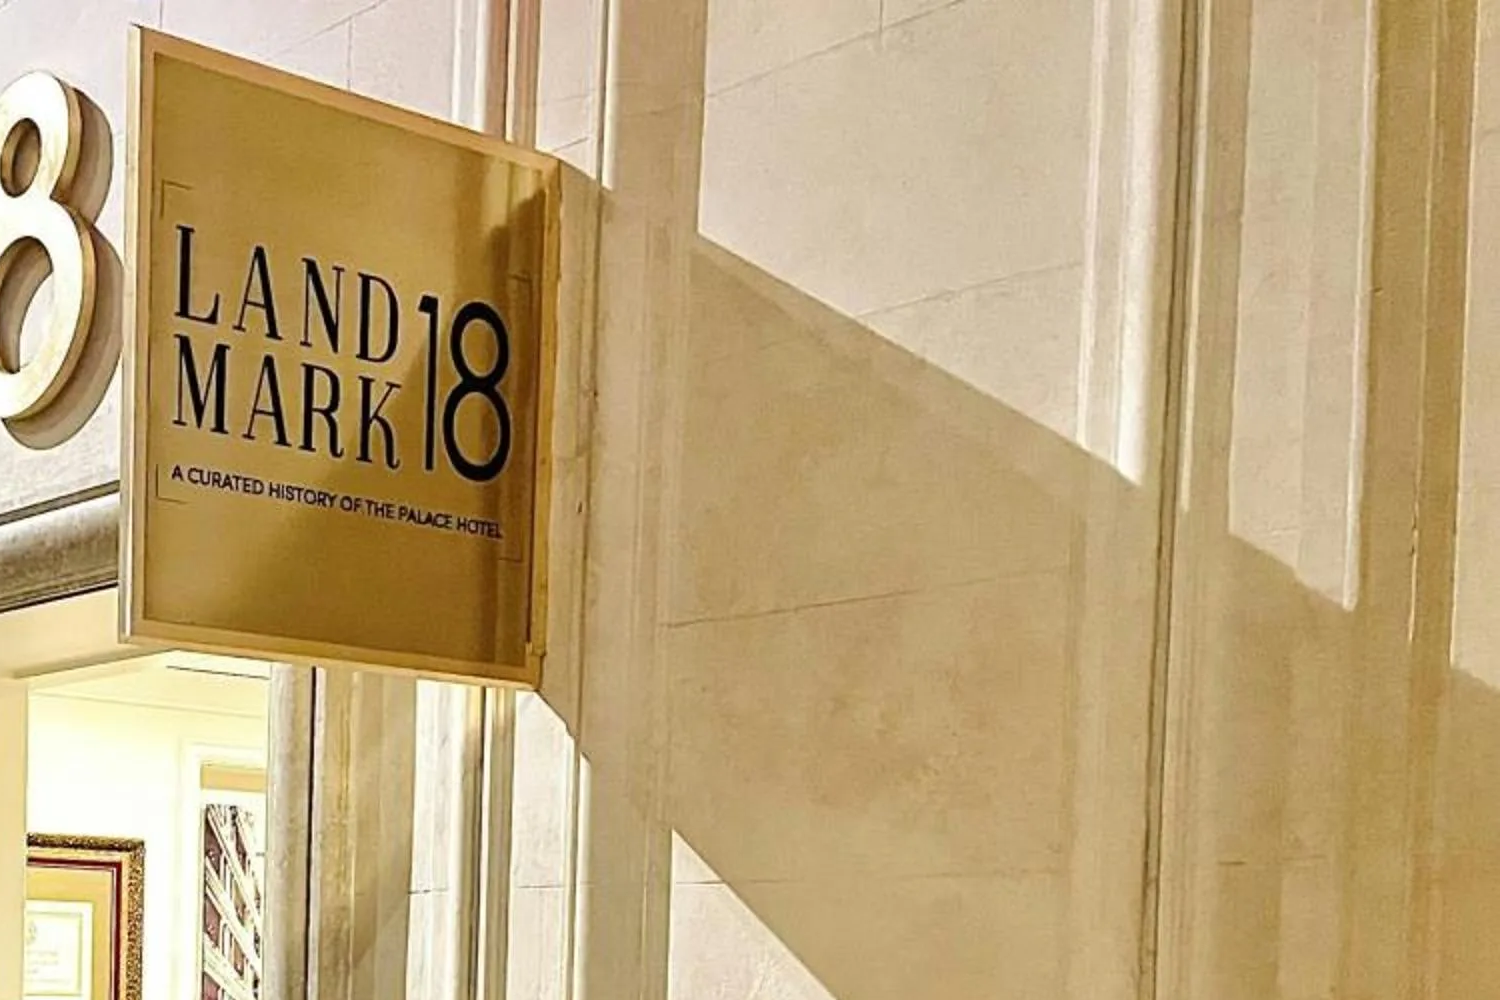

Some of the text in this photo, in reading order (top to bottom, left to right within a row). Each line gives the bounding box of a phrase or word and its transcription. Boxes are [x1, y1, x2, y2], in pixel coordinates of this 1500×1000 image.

[174, 224, 399, 363] LAND
[172, 333, 402, 470] MARK
[418, 294, 511, 483] 18
[171, 464, 504, 539] A CURATED HISTORY OF THE PALACE HOTEL
